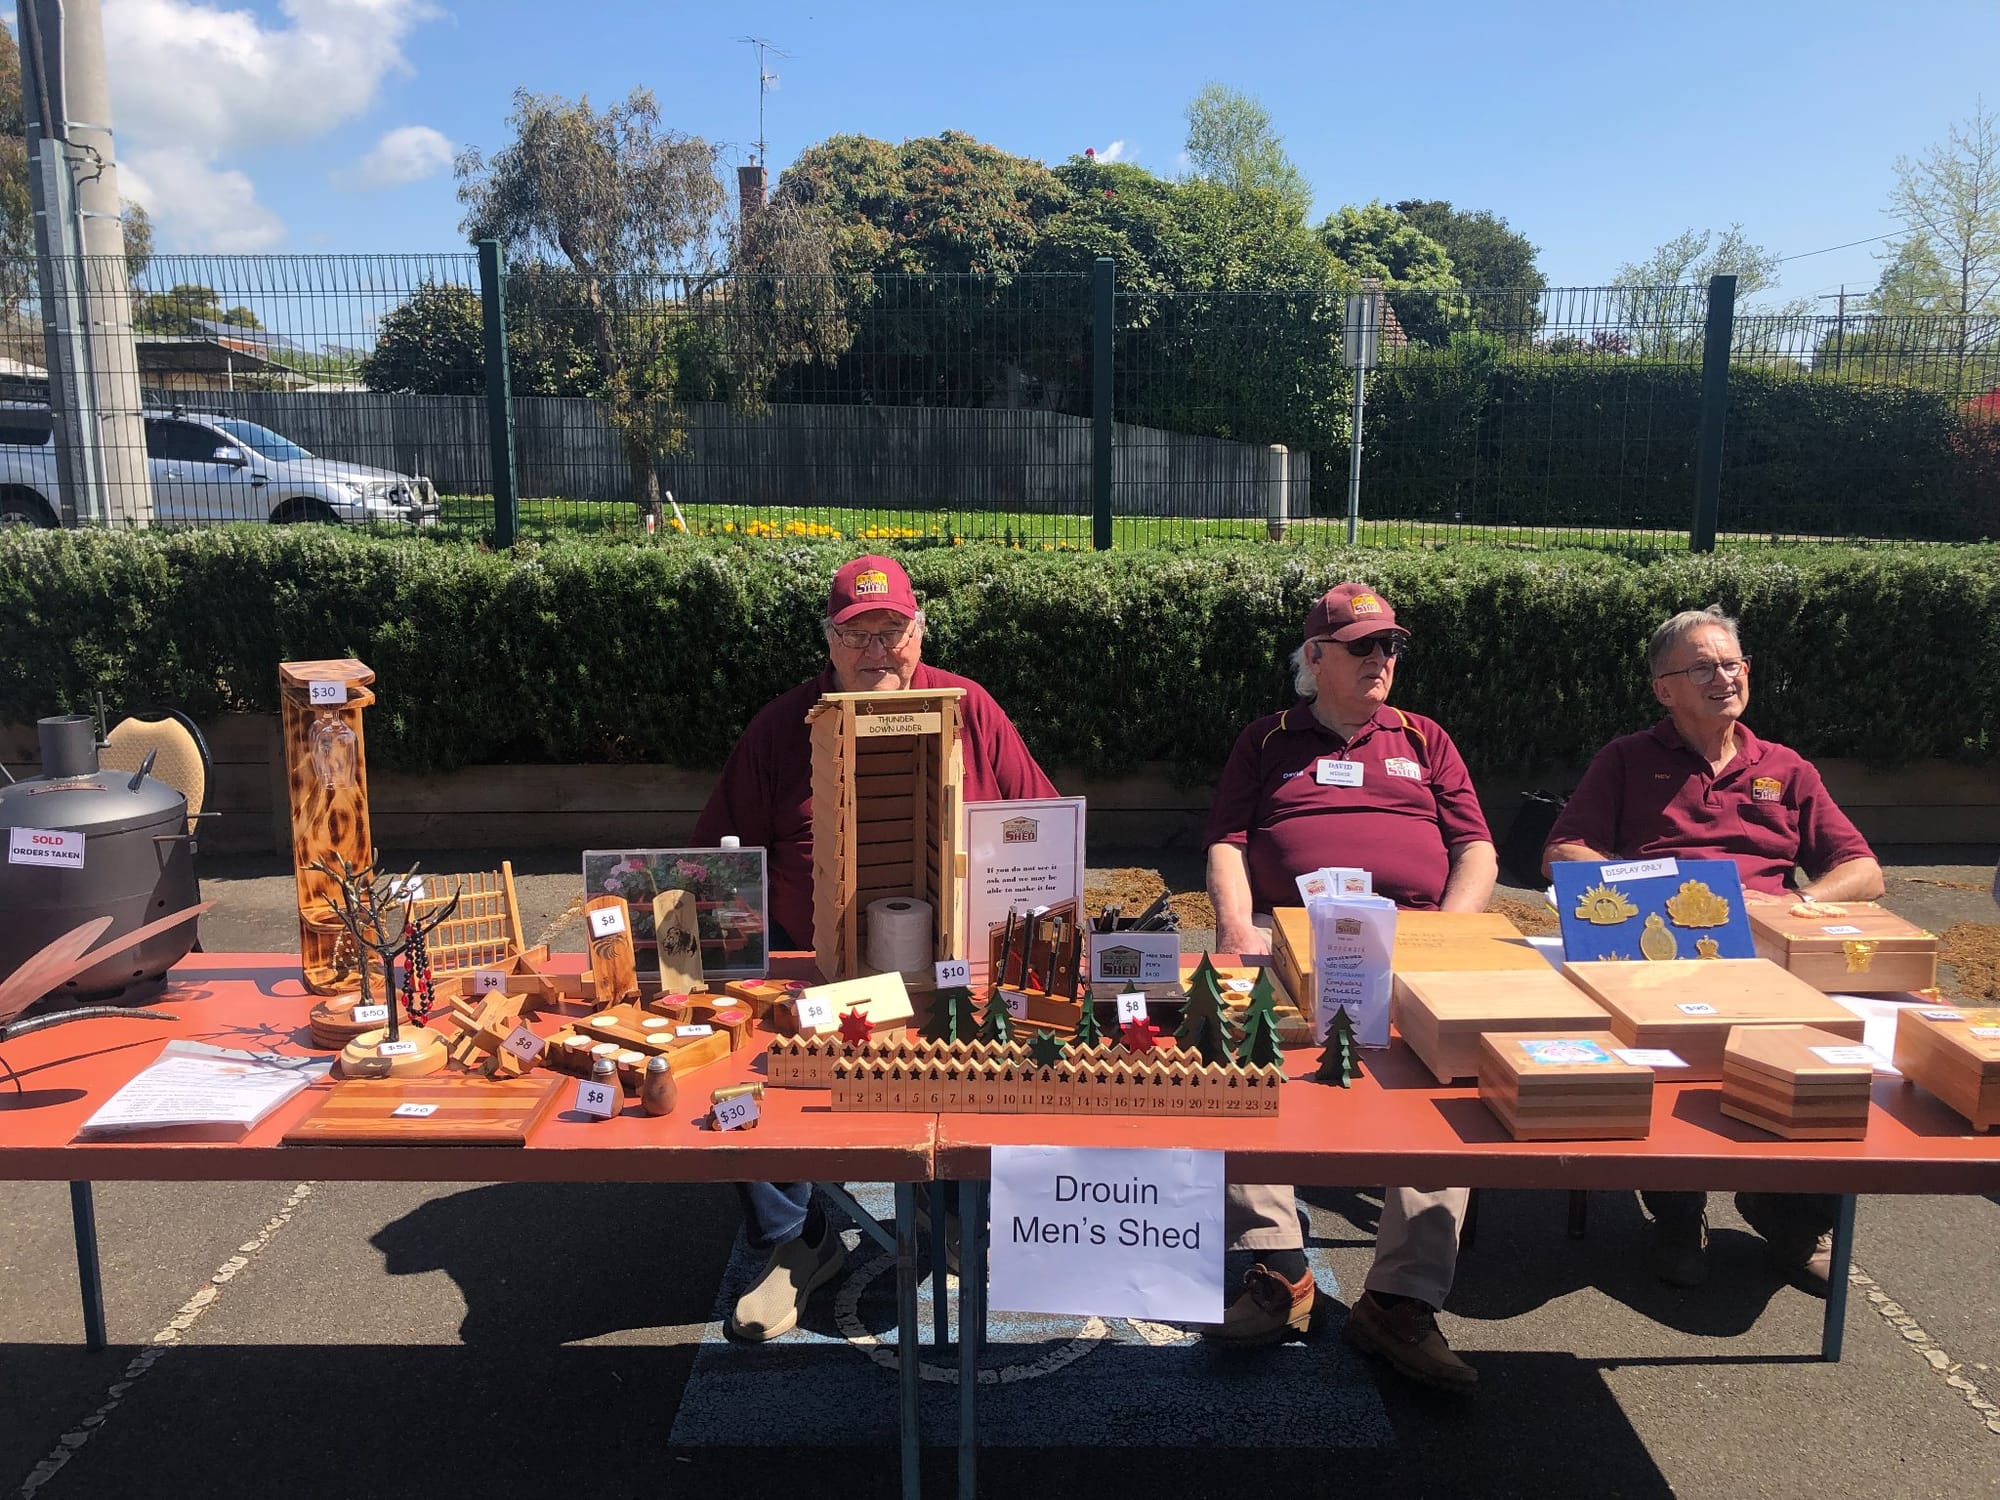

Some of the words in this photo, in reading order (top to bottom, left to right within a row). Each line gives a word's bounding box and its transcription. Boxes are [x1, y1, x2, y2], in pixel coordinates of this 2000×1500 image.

[312, 687, 336, 698] $30
[879, 716, 914, 724] THUNDER
[896, 724, 922, 732] UNDER
[32, 835, 64, 846] SOLD
[1005, 831, 1035, 841] SHED
[13, 848, 50, 857] ORDERS
[51, 850, 80, 859] TAKEN
[1605, 866, 1639, 877] DISPLAY
[1641, 864, 1662, 872] ONLY
[601, 914, 616, 926] $8
[942, 966, 965, 978] $10
[1103, 962, 1138, 975] SHED
[484, 977, 498, 987] $8
[808, 1005, 823, 1018] $8
[1126, 1001, 1139, 1012] $8
[361, 1009, 384, 1018] $50
[515, 1037, 533, 1050] $8
[792, 1068, 799, 1078] 2
[809, 1069, 817, 1078] 3
[587, 1090, 604, 1103] $8
[838, 1093, 844, 1102] 1
[856, 1093, 864, 1103] 2
[875, 1093, 882, 1102] 3
[893, 1093, 900, 1103] 4
[912, 1093, 919, 1103] 5
[930, 1093, 938, 1103] 6
[949, 1093, 957, 1104] 7
[968, 1094, 975, 1104] 8
[986, 1094, 994, 1104] 9
[1003, 1094, 1016, 1104] 10
[1022, 1095, 1033, 1104] 11
[1041, 1095, 1053, 1105] 12
[1058, 1096, 1071, 1106] 13
[1077, 1096, 1089, 1106] 14
[1096, 1097, 1108, 1107] 15
[1114, 1097, 1127, 1108] 16
[1133, 1098, 1146, 1108] 17
[1152, 1098, 1164, 1108] 18
[1171, 1098, 1183, 1108] 19
[1188, 1099, 1202, 1108] 20
[1207, 1099, 1219, 1109] 21
[1226, 1100, 1240, 1109] 22
[1245, 1100, 1259, 1110] 23
[1263, 1100, 1277, 1110] 24
[720, 1105, 745, 1124] $30
[1055, 1175, 1159, 1205] Drouin
[1012, 1216, 1106, 1245] Men's
[1118, 1218, 1200, 1250] Shed
